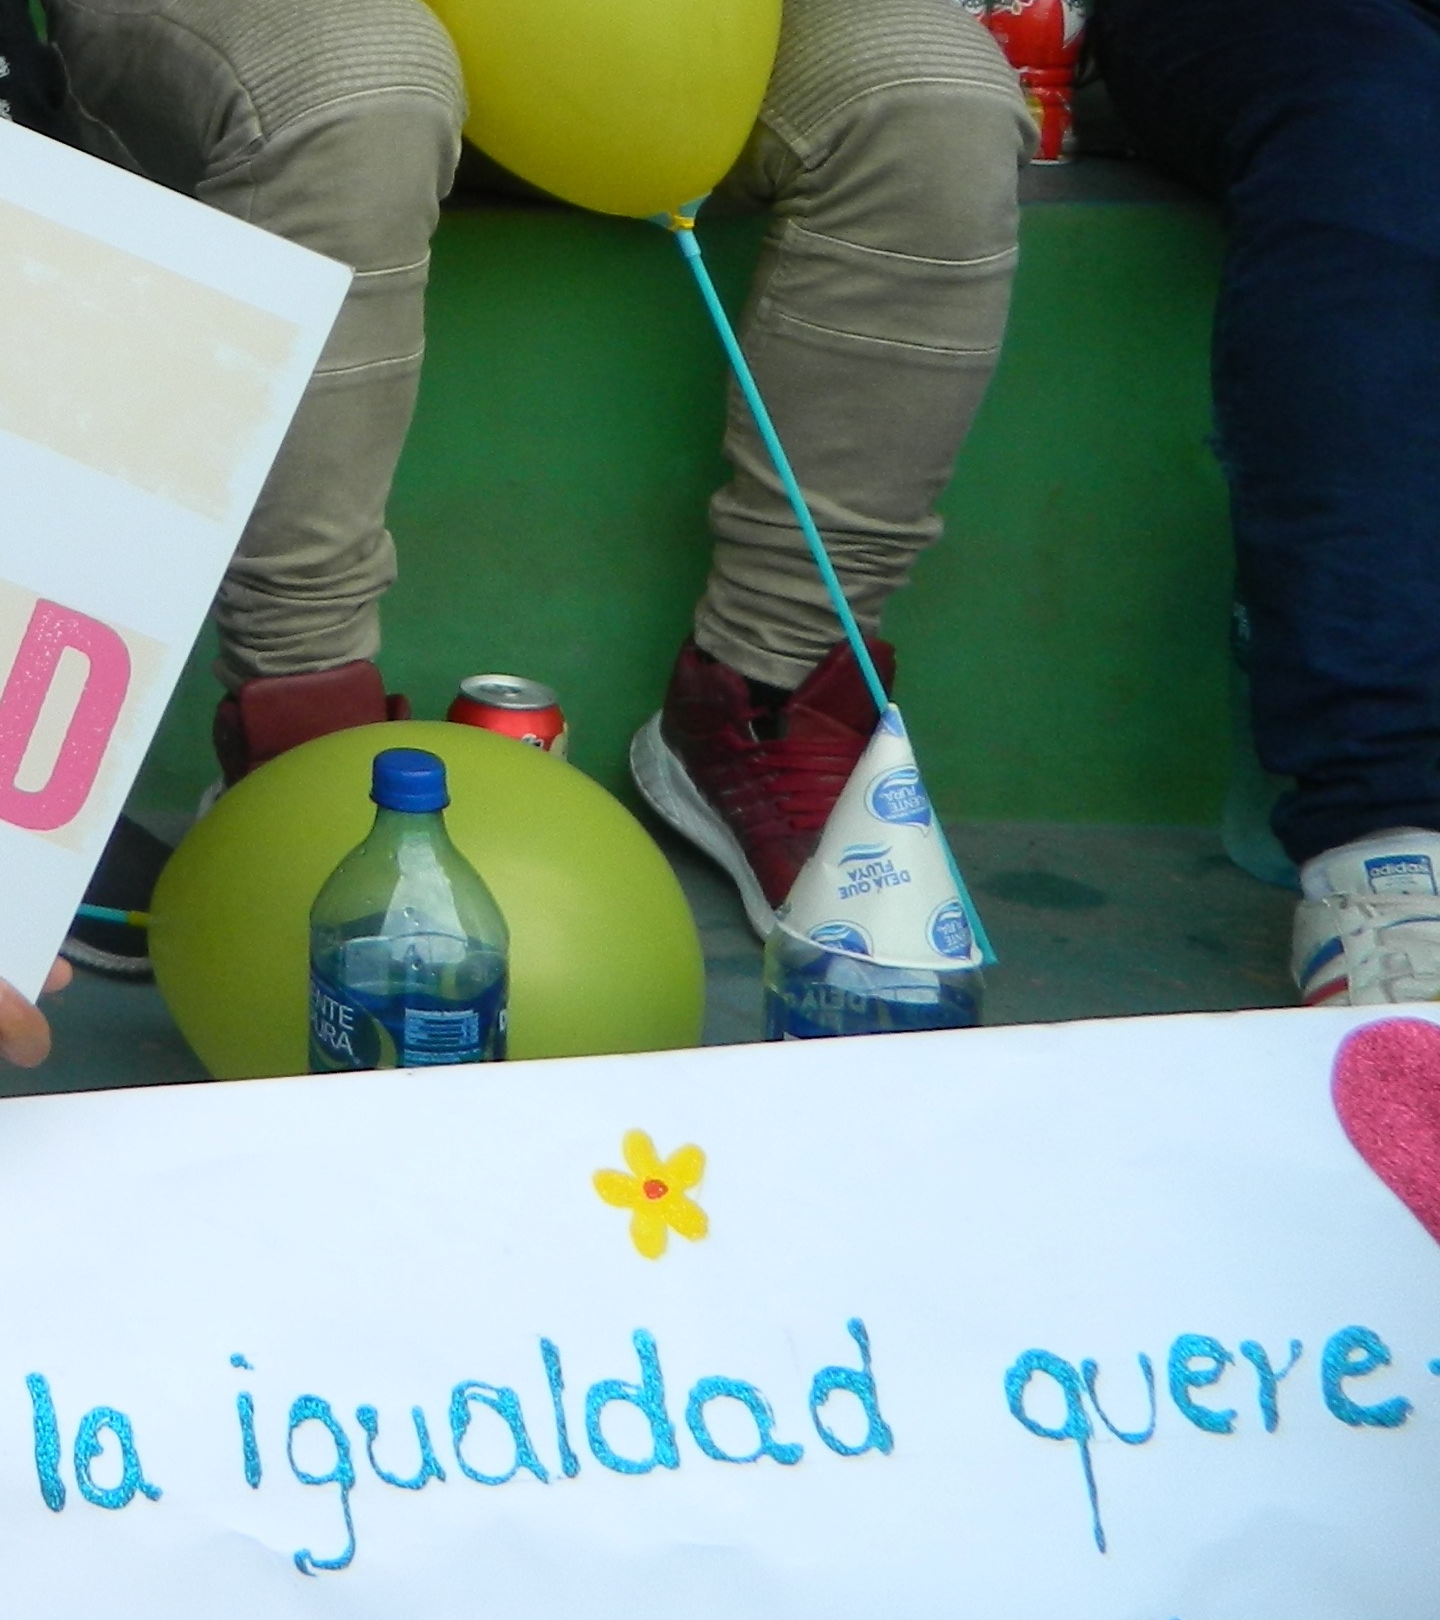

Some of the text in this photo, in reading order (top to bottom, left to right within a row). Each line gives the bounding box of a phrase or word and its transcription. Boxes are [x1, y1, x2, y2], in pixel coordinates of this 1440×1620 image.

[847, 859, 896, 880] FLUYA
[1369, 861, 1431, 877] adidas
[837, 880, 872, 900] QUE
[25, 1371, 164, 1513] la
[229, 1316, 896, 1578] igualdad
[1003, 1324, 1440, 1555] quere
